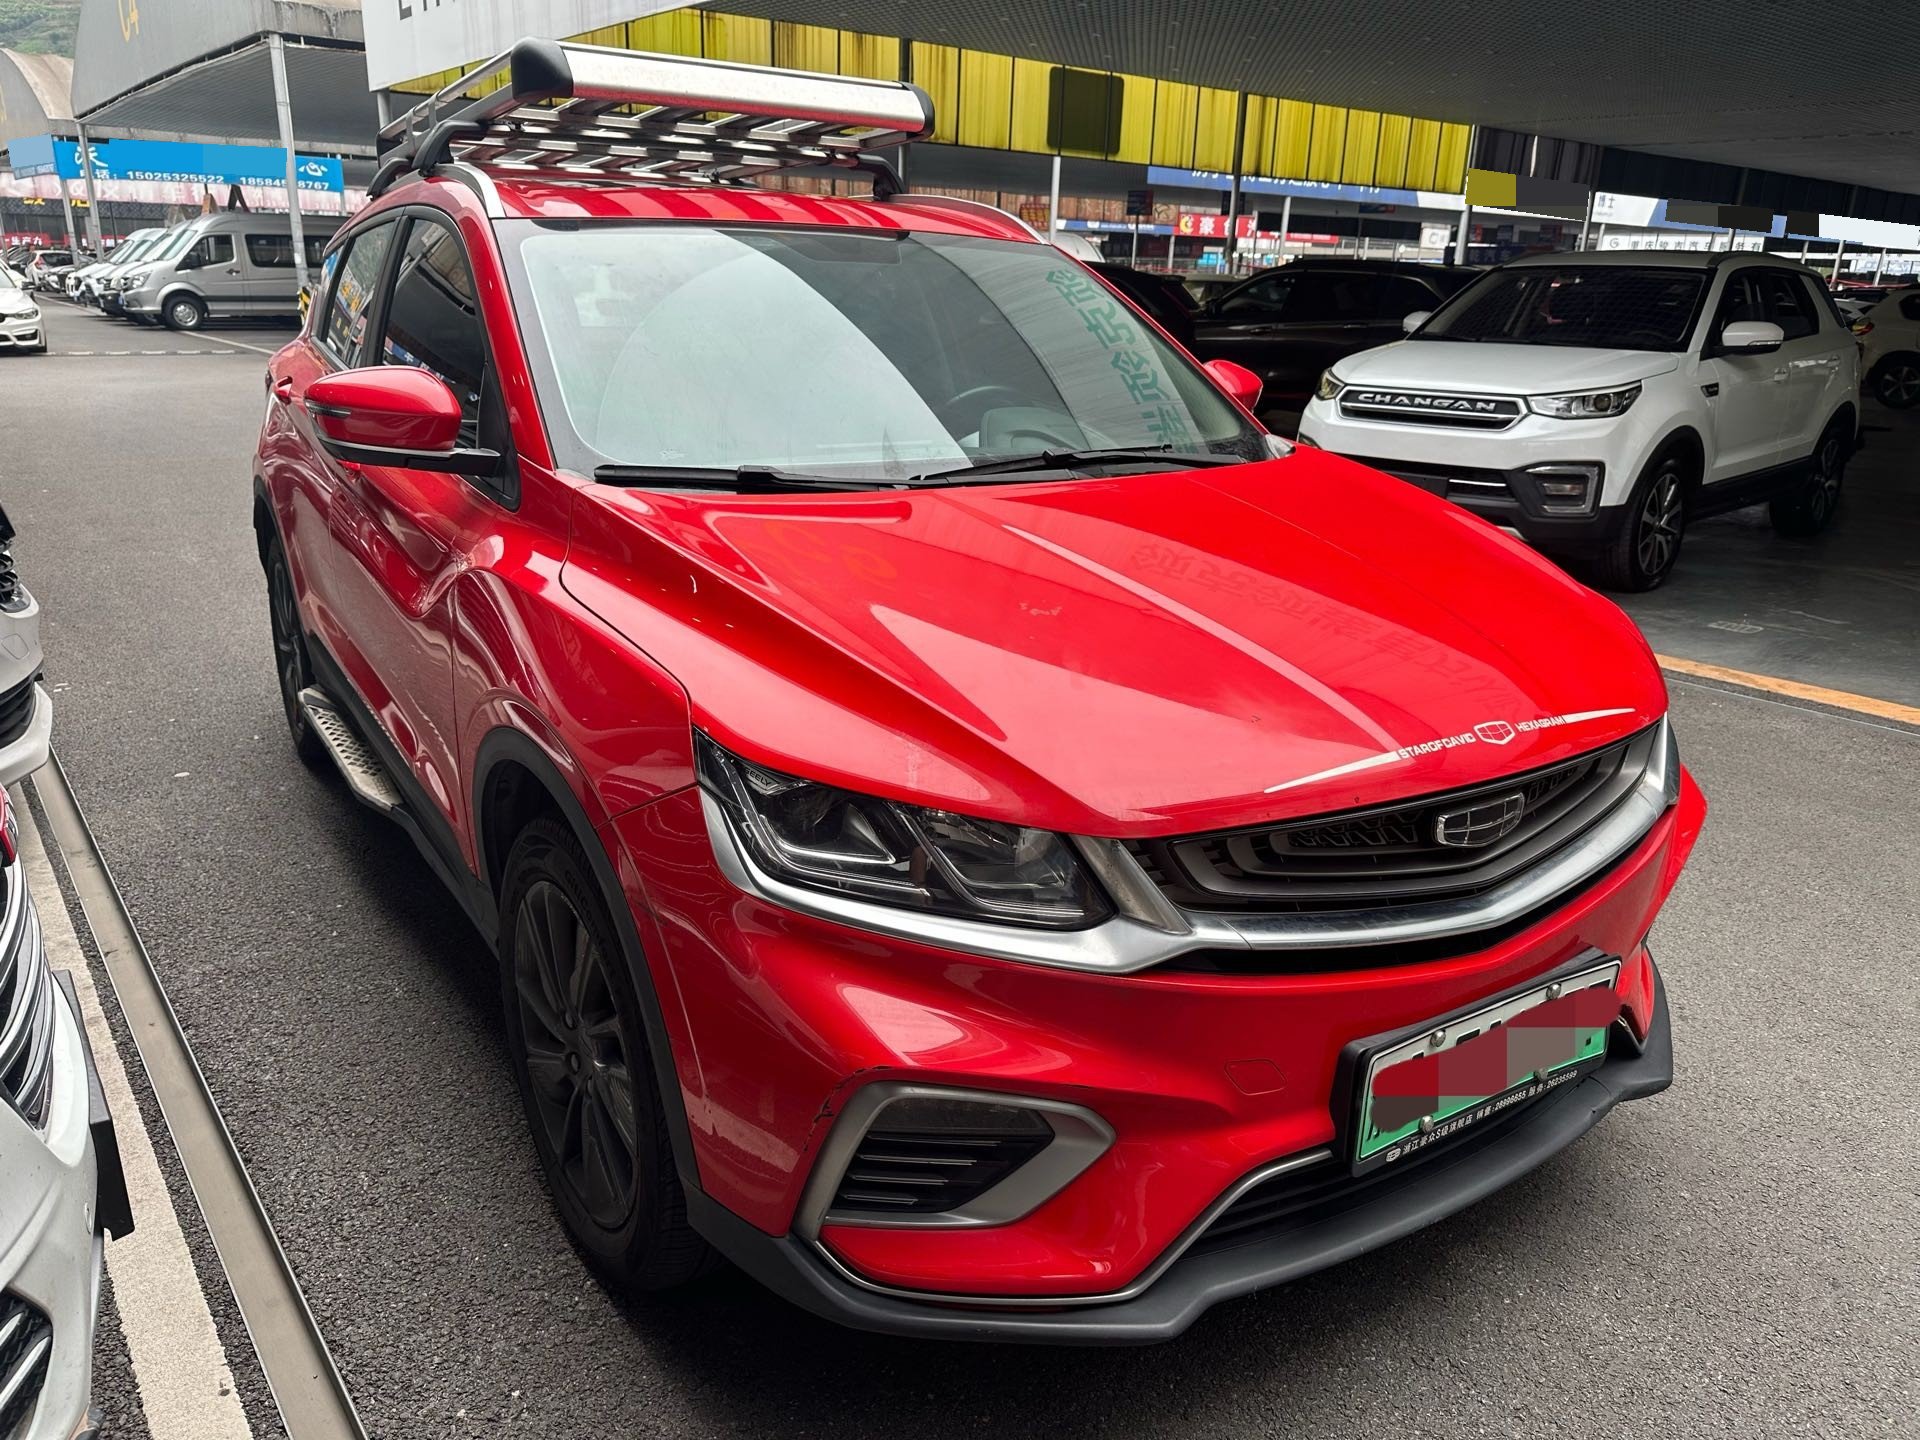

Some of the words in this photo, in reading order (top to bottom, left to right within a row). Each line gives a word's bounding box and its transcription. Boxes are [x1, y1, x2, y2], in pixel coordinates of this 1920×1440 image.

[127, 171, 225, 184] 15025325522
[240, 177, 329, 190] 1858458767
[1358, 393, 1497, 412] CHANGAN
[1515, 716, 1565, 733] HEXAGRAM
